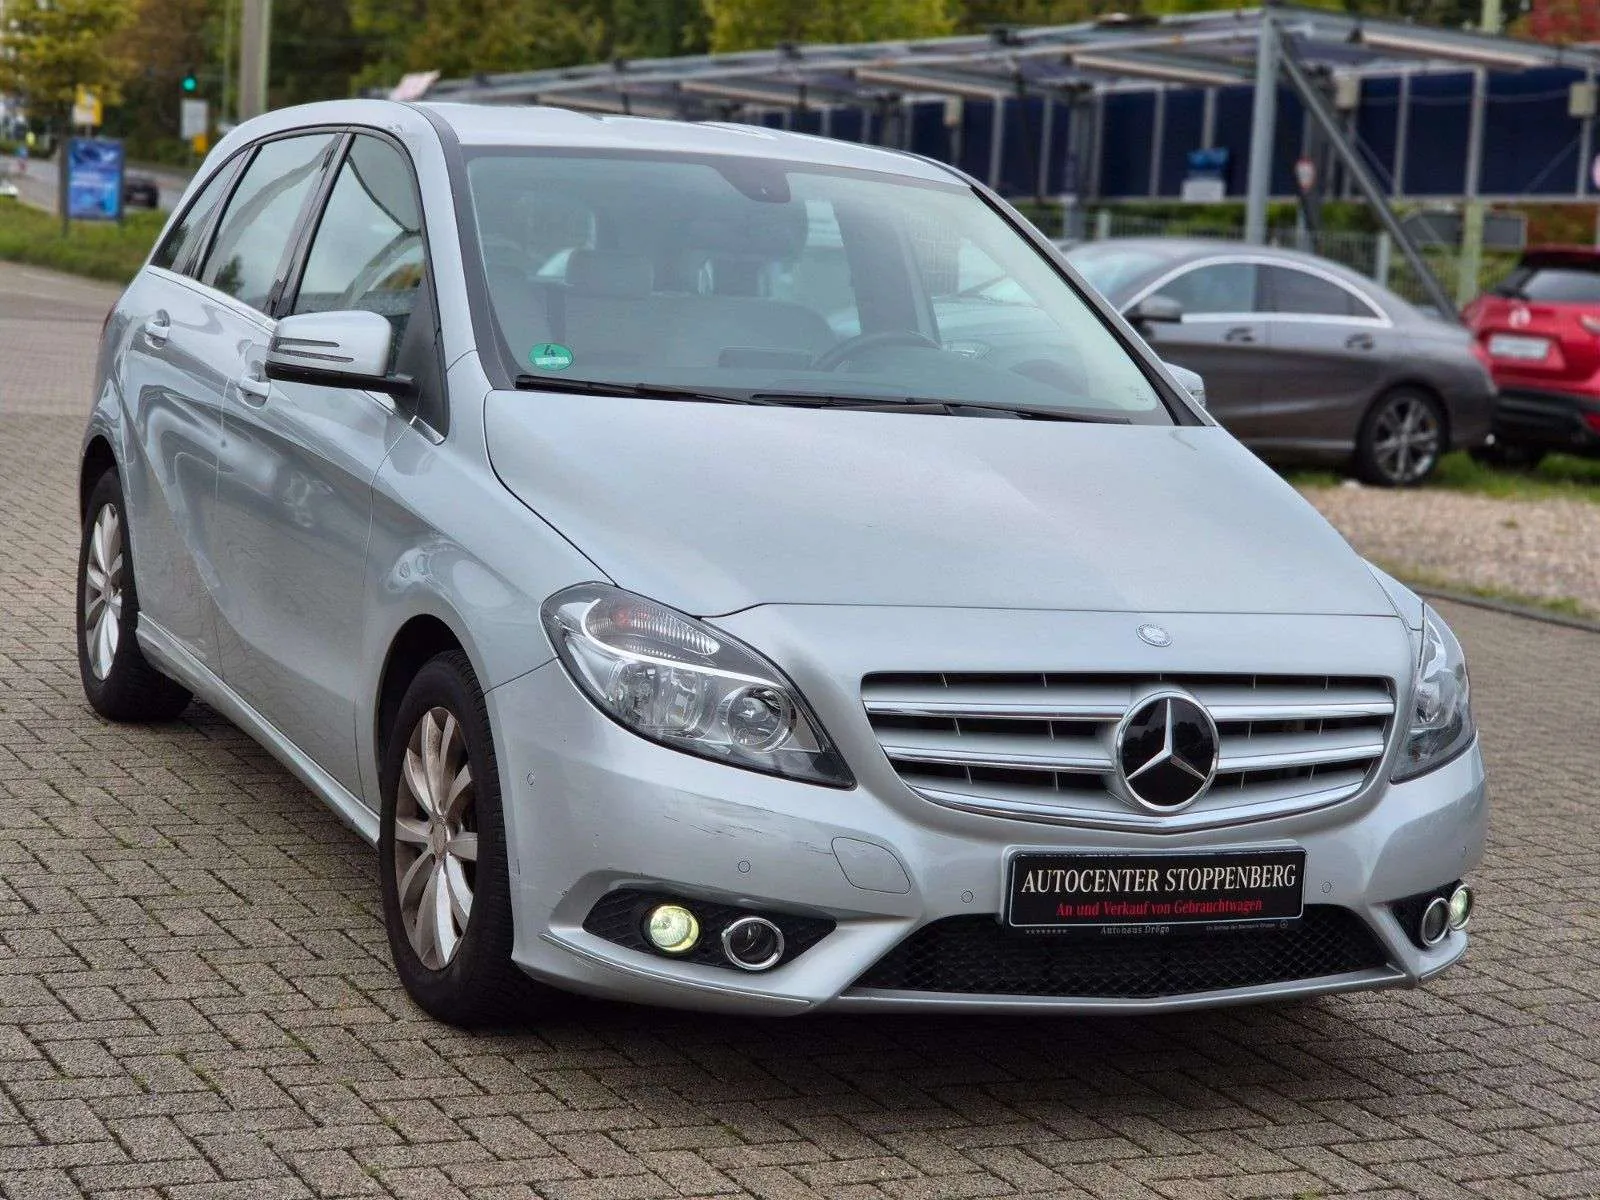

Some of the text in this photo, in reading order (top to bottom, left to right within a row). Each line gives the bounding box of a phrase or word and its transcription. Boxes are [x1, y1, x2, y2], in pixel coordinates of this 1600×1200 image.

[1021, 864, 1297, 893] AUTOCENTER STOPPENBERG
[1056, 899, 1263, 917] An und Verkauf von Gebrauchtwagen
